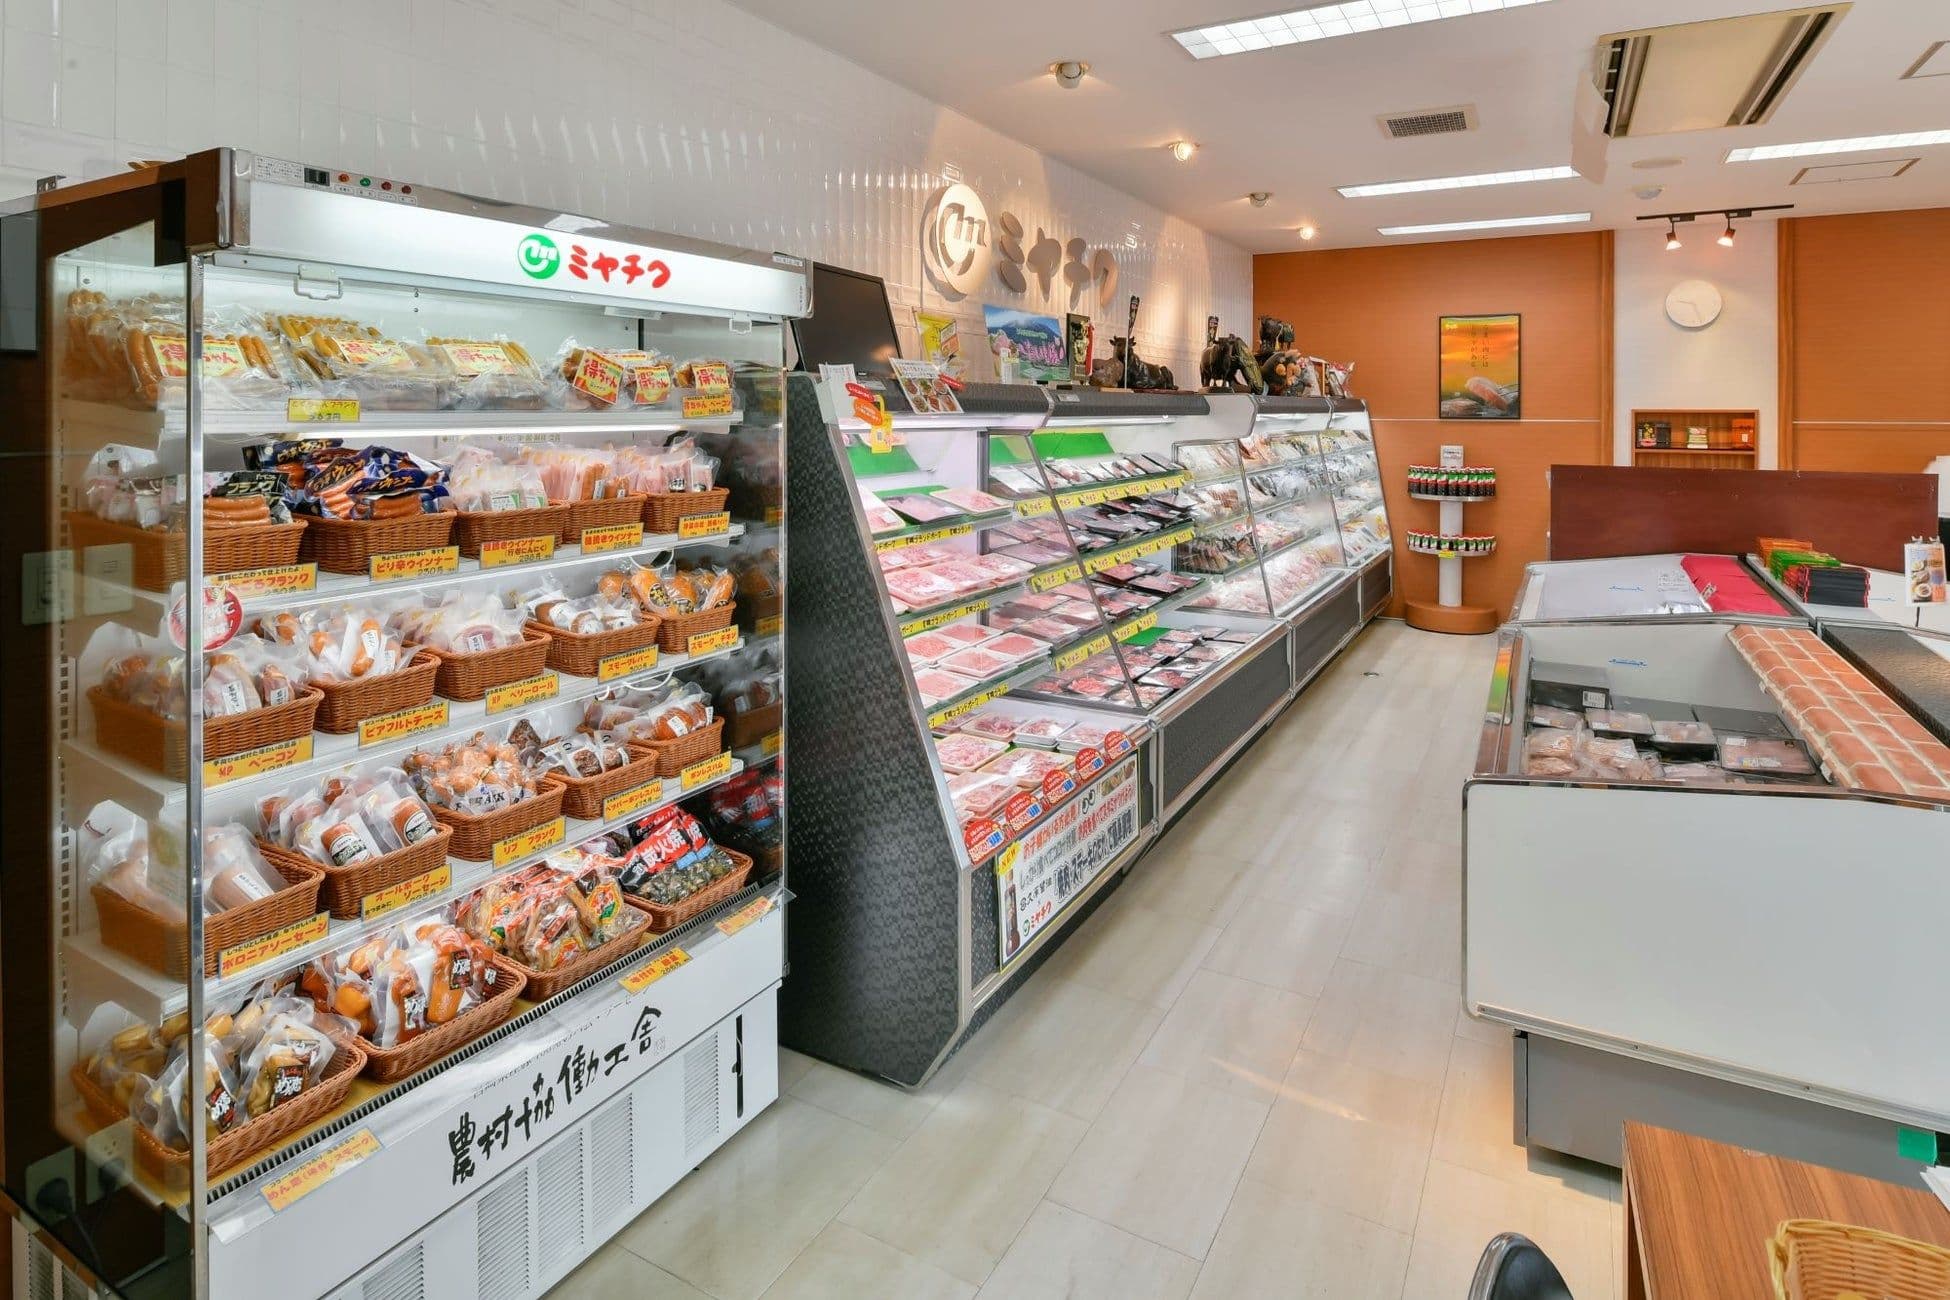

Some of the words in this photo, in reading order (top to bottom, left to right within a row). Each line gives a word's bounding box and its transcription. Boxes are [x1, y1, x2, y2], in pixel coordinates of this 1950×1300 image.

[568, 244, 671, 289] ミヤチク
[248, 750, 297, 768] ベーコン
